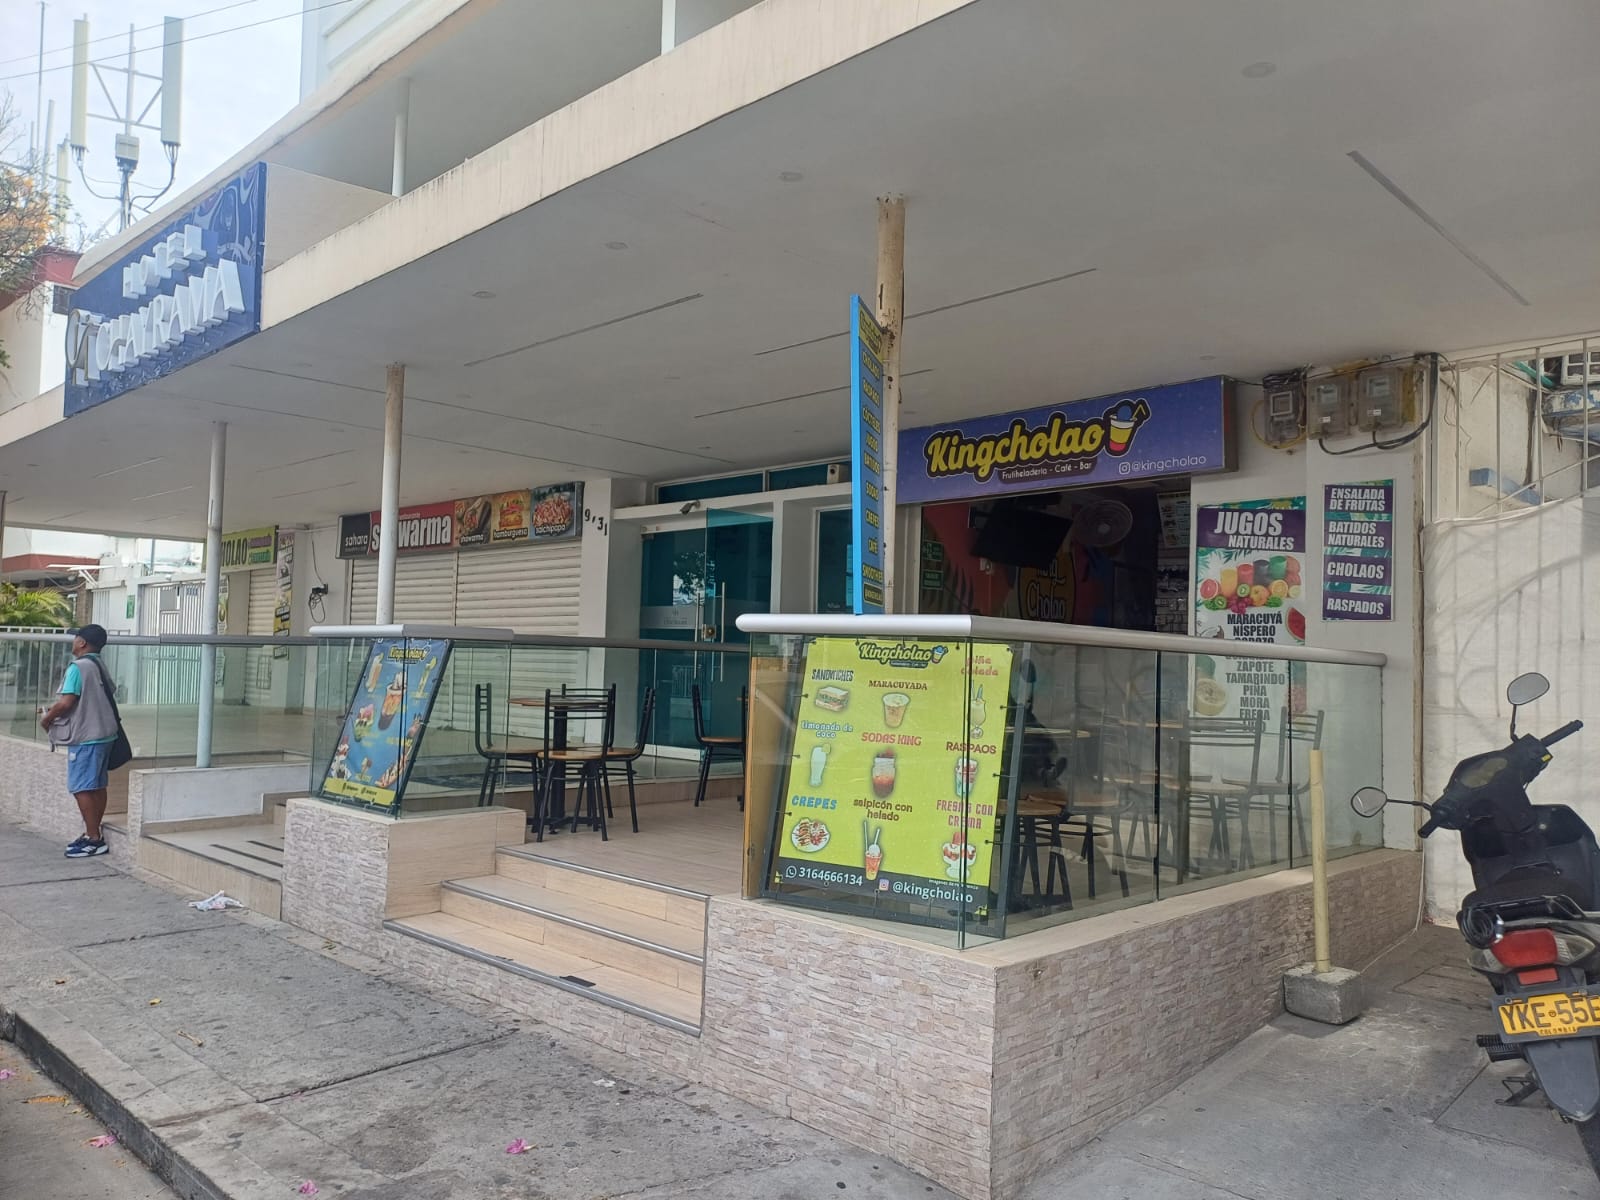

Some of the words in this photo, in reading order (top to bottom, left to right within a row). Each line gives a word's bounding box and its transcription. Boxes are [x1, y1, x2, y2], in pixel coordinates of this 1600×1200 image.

[122, 223, 207, 299] HOTEL
[927, 417, 1104, 479] Kingcholao
[1132, 455, 1207, 472] @kingcholao
[1331, 488, 1385, 500] ENSALADA
[1330, 501, 1343, 511] DE
[1345, 501, 1385, 511] FRUTAS
[1214, 512, 1283, 535] JUGOS
[1329, 522, 1377, 534] BATIDOS
[345, 533, 368, 546] sahara
[372, 515, 452, 551] swarma
[1228, 535, 1294, 550] NATURALES
[1328, 534, 1385, 548] NATURALES
[1327, 562, 1384, 579] CHOLAOS
[1327, 599, 1384, 614] RASPADOS
[1227, 611, 1282, 624] MARACUYÁ
[860, 641, 933, 663] Kingcholao
[1237, 661, 1274, 672] ZAPOTE
[869, 680, 928, 690] MARACUYADA
[1226, 673, 1285, 685] TAMARINDO
[1240, 697, 1269, 708] MORA
[861, 732, 896, 744] SODAS
[898, 734, 922, 746] KING
[946, 741, 997, 754] RASPAOS
[792, 795, 837, 810] CREPES
[854, 798, 893, 811] salpicón
[895, 803, 913, 813] con
[867, 809, 900, 822] helado
[976, 804, 993, 816] CON
[799, 867, 863, 887] 3164666134
[893, 881, 973, 903] @kingcholao
[1501, 1002, 1551, 1031] YKE
[1540, 1027, 1576, 1036] COLOMBIA
